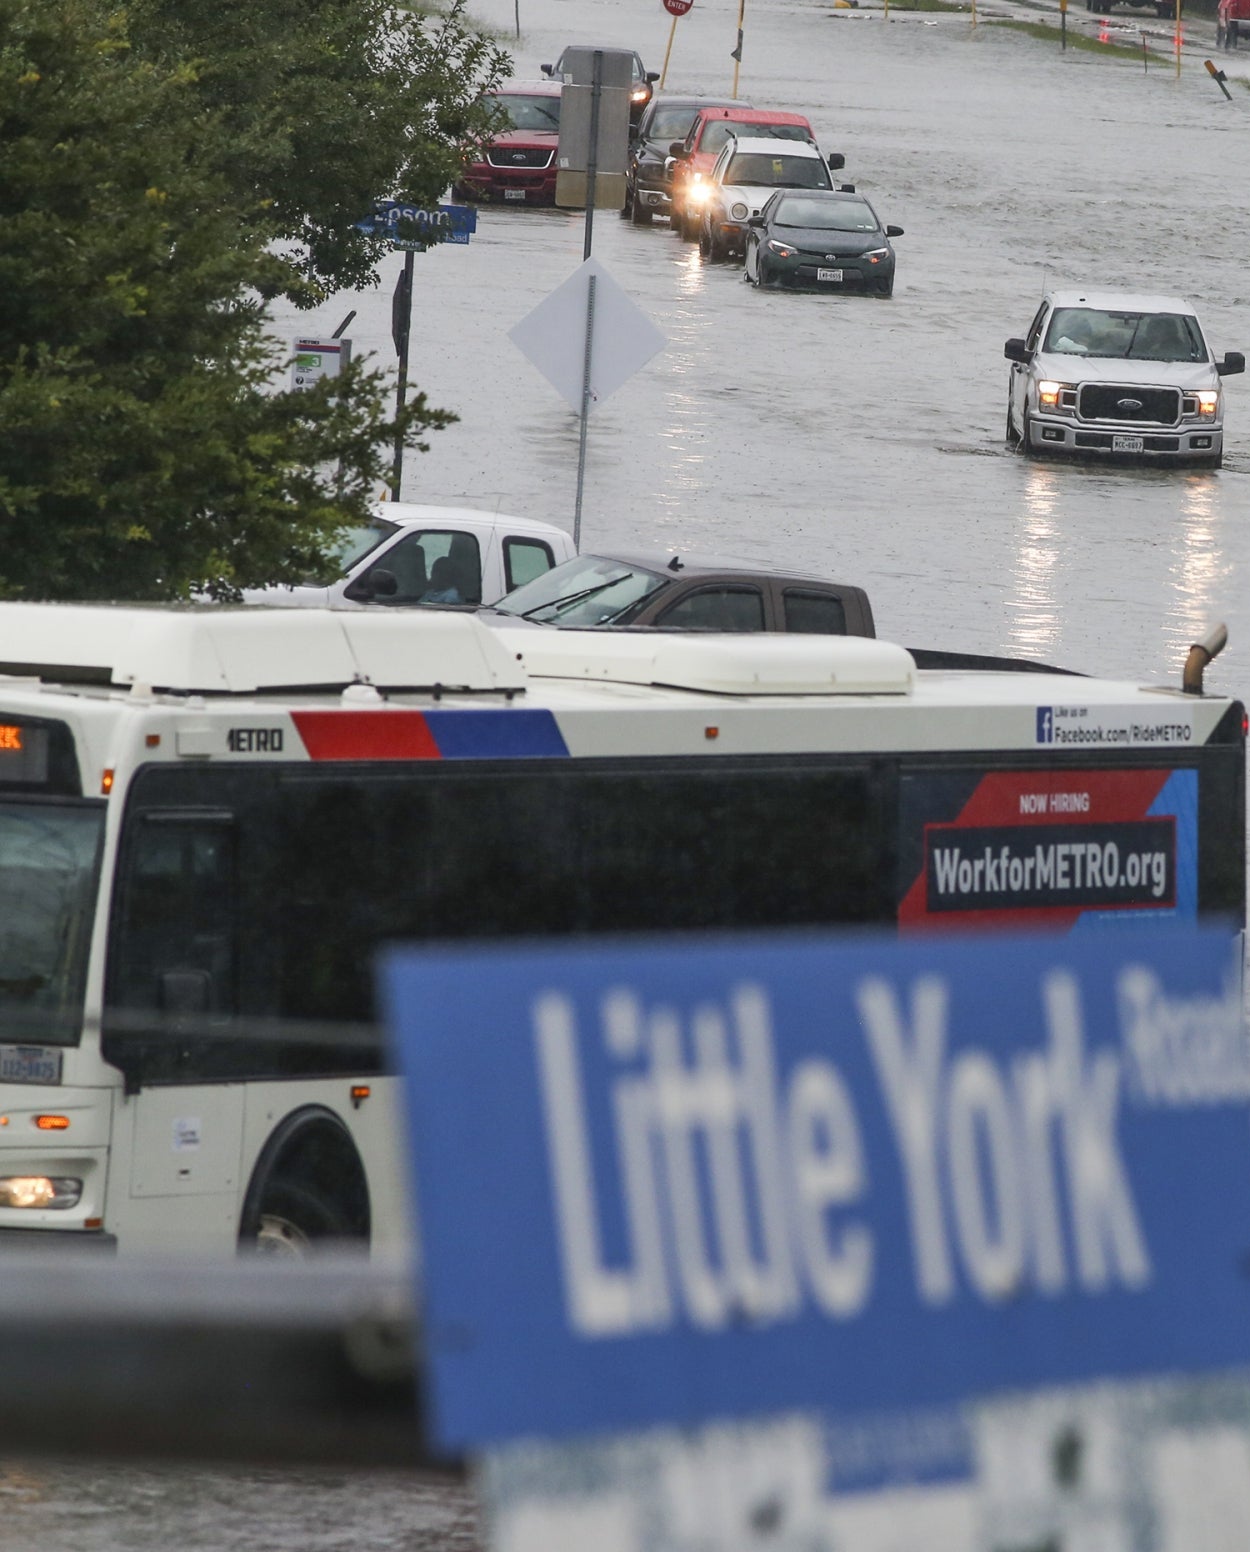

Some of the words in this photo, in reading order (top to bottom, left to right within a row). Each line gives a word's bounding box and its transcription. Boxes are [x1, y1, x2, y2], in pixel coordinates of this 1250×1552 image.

[1055, 706, 1068, 718] Like
[1070, 708, 1078, 717] us
[1079, 708, 1088, 717] on
[1054, 724, 1191, 744] Facebook.com/RideMETRO
[1020, 794, 1047, 814] NOW
[1050, 793, 1090, 813] HIRING
[934, 841, 1166, 897] WorkforMETRO.org
[533, 985, 872, 1338] Little
[857, 972, 1150, 1304] York
